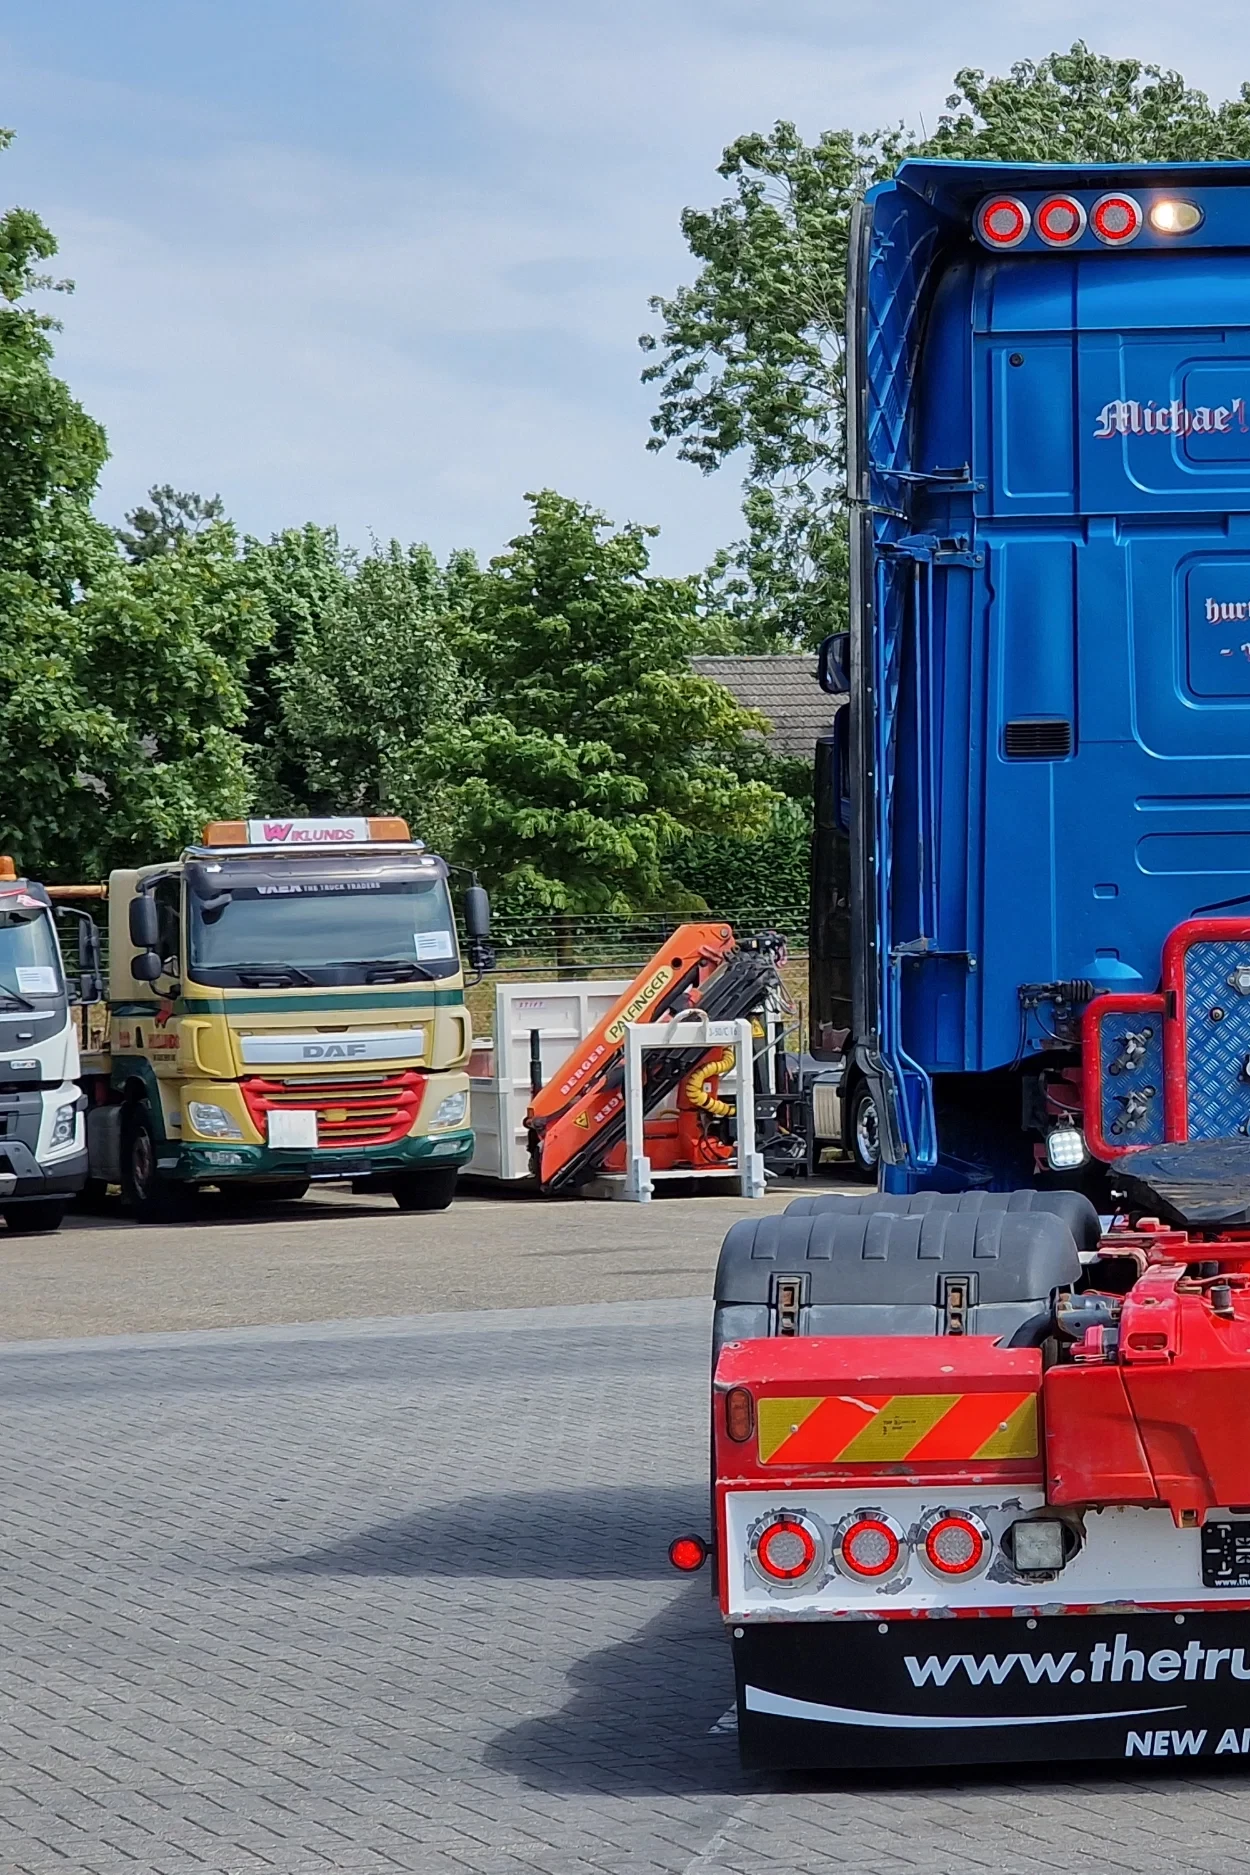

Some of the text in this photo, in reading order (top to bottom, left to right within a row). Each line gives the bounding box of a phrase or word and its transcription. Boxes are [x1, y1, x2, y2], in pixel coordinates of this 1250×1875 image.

[263, 823, 356, 842] WIKLUNDS
[609, 970, 669, 1039] PALFINGER
[303, 1044, 367, 1058] DAF
[560, 1044, 607, 1096] BERGER
[1125, 1729, 1207, 1757] NEW
